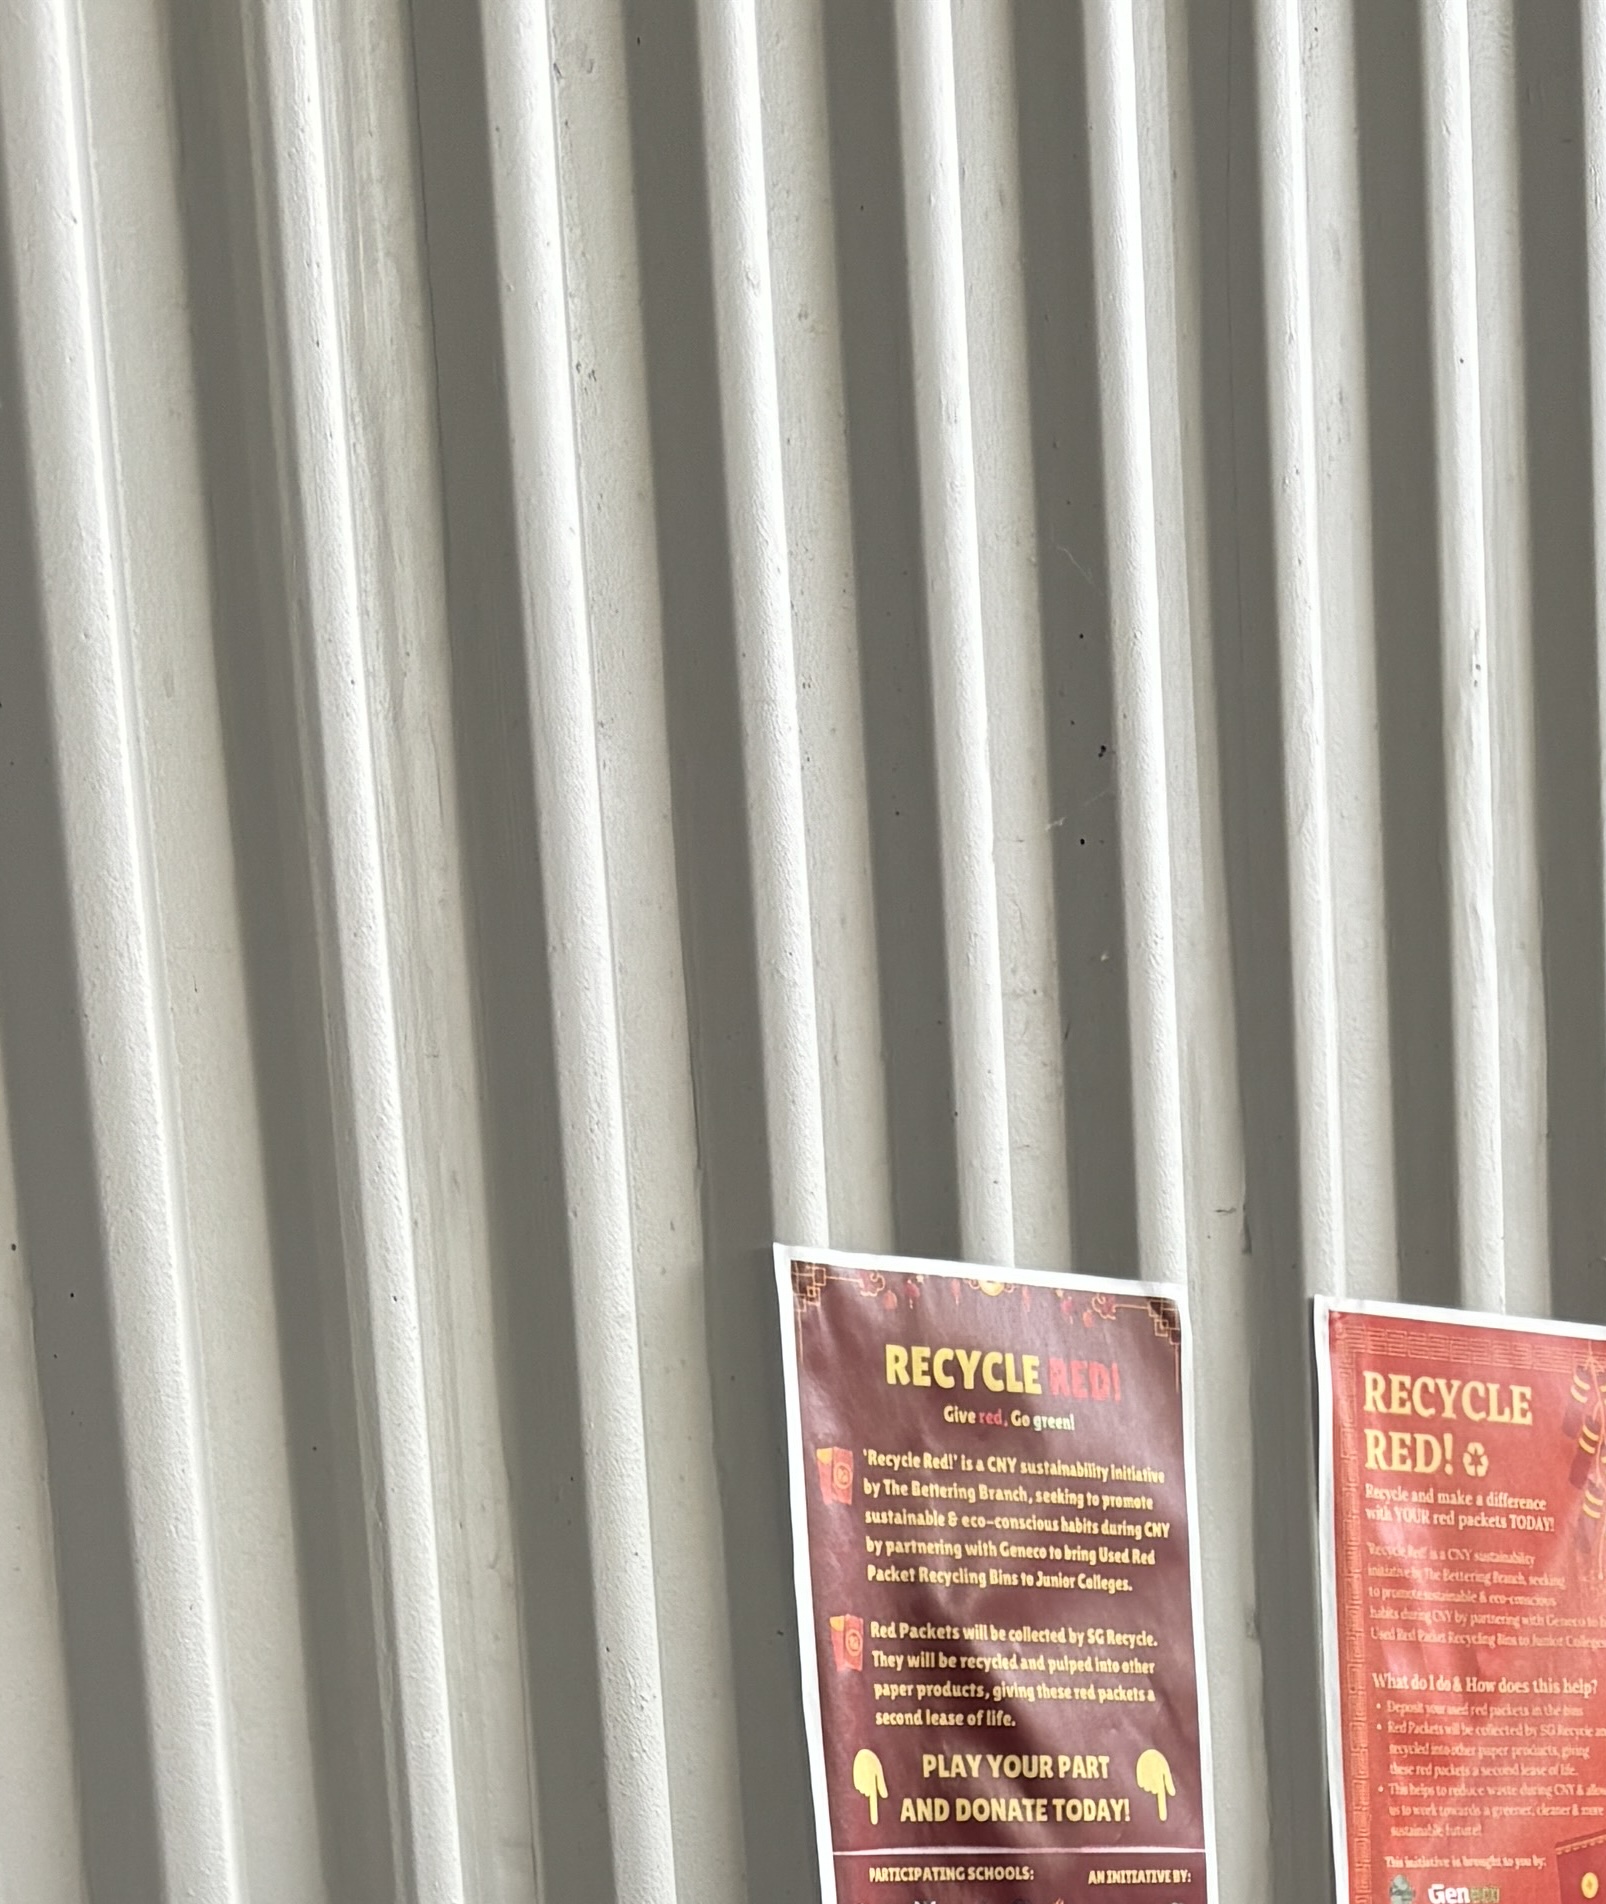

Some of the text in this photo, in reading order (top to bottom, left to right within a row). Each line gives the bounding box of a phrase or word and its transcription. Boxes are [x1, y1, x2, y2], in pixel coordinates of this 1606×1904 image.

[885, 1344, 1121, 1403] RECYCLE RED!
[1363, 1371, 1532, 1426] RECYCLE
[944, 1406, 976, 1424] Give
[1011, 1409, 1030, 1427] Go
[1033, 1415, 1075, 1431] green!
[1364, 1428, 1454, 1476] RED!
[961, 1455, 973, 1471] is
[976, 1459, 985, 1472] a
[987, 1456, 1017, 1473] CNY
[1020, 1460, 1108, 1482] sustainability
[1110, 1465, 1165, 1483] initiative
[863, 1477, 1153, 1512] by The Bettering Branch, seeking to promote
[865, 1509, 945, 1527] sustainable
[1061, 1519, 1099, 1534] habits
[1101, 1522, 1142, 1539] during
[1144, 1522, 1171, 1538] CNY
[1366, 1504, 1555, 1532] with YOUR red packets TODAY!
[867, 1565, 1133, 1593] Packet Recycling Bins to Junior Colleges.
[870, 1622, 1158, 1648] Red Packets will be collected by SG Recycle.
[874, 1681, 1156, 1703] paper products, giving these red packets a
[875, 1710, 1016, 1727] second lease of life.
[923, 1754, 1110, 1779] PLAY YOUR PART
[900, 1799, 1131, 1823] AND DONATE TODAY!
[869, 1866, 1034, 1882] PARTICIPATING SCHOOLS:
[1088, 1869, 1191, 1884] AN INITIATIVE BY:
